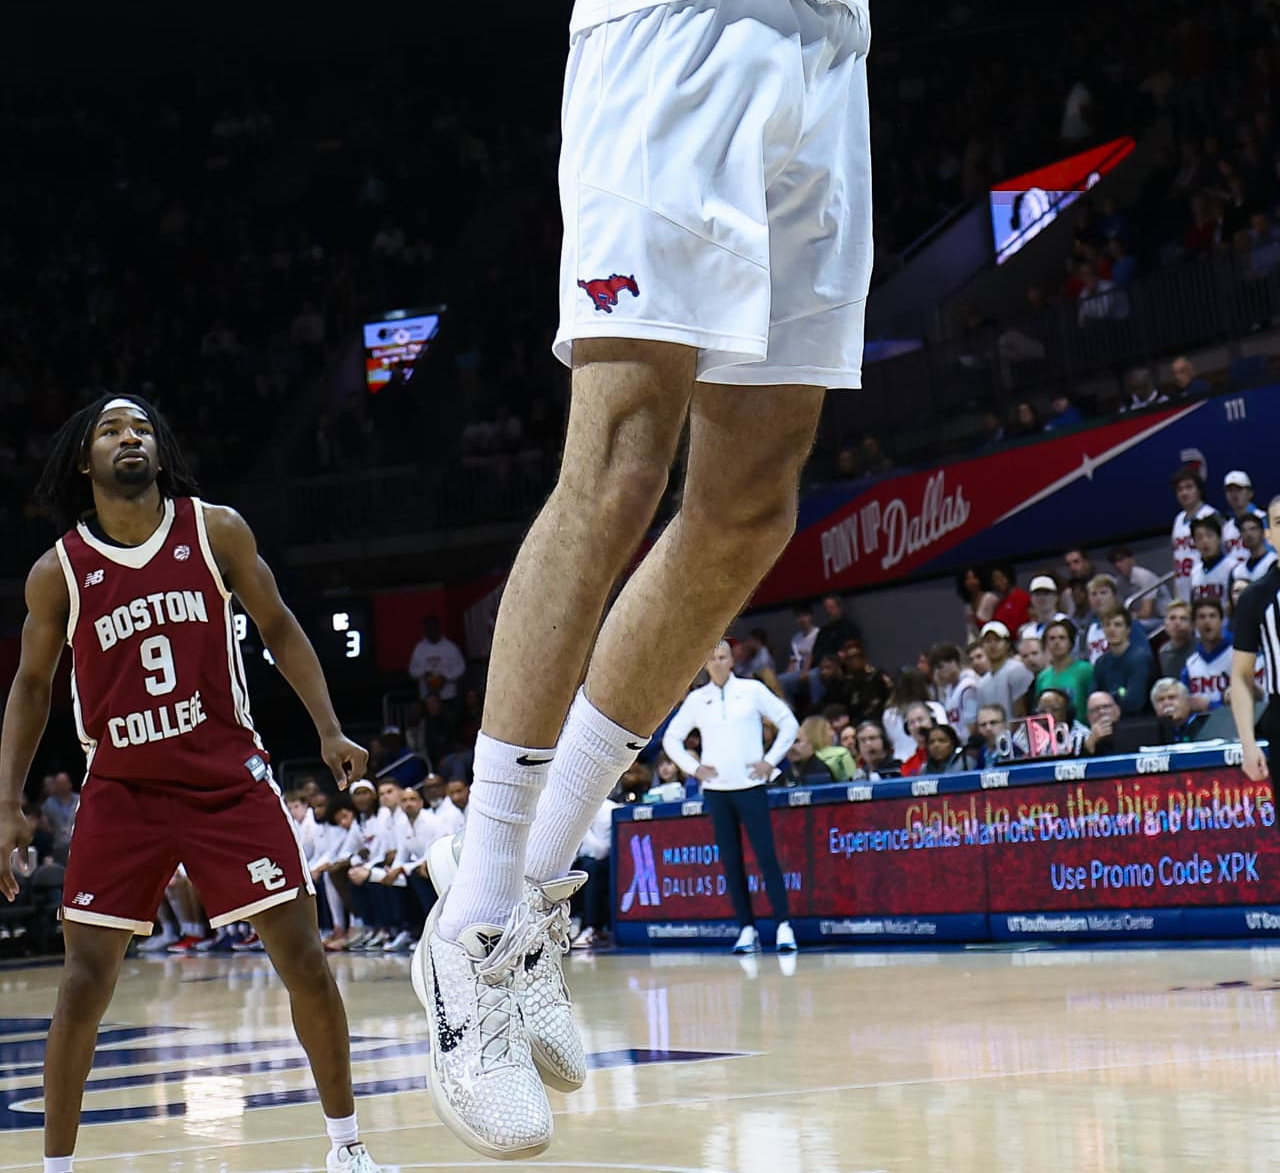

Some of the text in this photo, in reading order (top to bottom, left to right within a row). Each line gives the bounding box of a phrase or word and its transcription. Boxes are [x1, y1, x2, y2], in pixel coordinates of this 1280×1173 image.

[1224, 398, 1246, 421] 111
[821, 470, 971, 580] PONY UP Dallas
[94, 590, 209, 652] BOSTON
[345, 630, 361, 658] 3
[140, 634, 177, 696] 9
[1190, 677, 1231, 694] SMU
[1054, 761, 1087, 781] UTSW
[1136, 754, 1171, 774] UTSW
[663, 844, 720, 865] MARRIOT
[829, 827, 909, 858] Experience
[1051, 852, 1260, 891] Use Promo Code XPK
[662, 875, 712, 897] DALLAS
